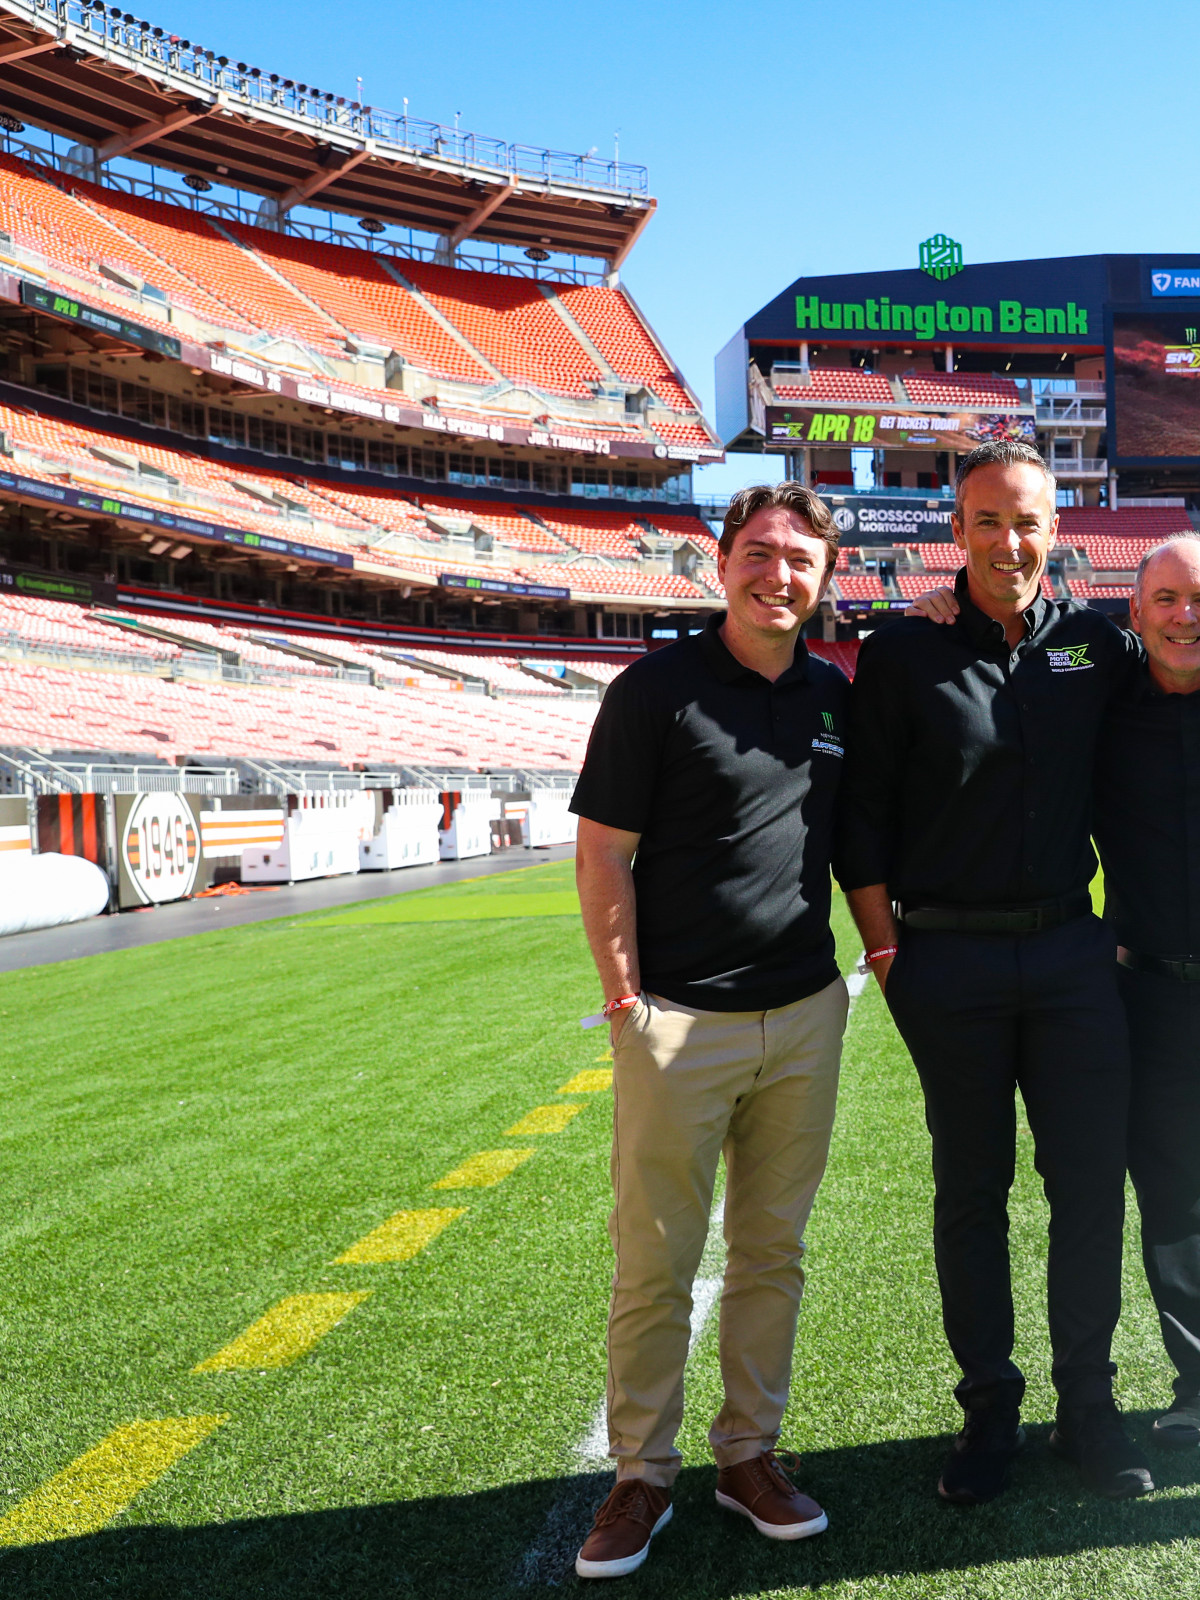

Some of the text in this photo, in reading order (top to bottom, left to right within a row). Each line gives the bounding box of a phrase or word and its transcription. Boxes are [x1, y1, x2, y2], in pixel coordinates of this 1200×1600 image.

[54, 297, 69, 315] APR
[70, 303, 79, 318] 18
[796, 296, 1088, 340] Huntington Bank
[266, 372, 281, 392] 76
[423, 414, 447, 430] MAC
[447, 418, 489, 437] SPEEDIE
[807, 414, 851, 441] APR
[852, 415, 876, 442] 18
[879, 415, 960, 431] GET TICKETS TODAY!
[528, 431, 611, 454] JOE THOMAS 73
[859, 523, 918, 534] MORTGAGE
[142, 814, 185, 879] 1946
